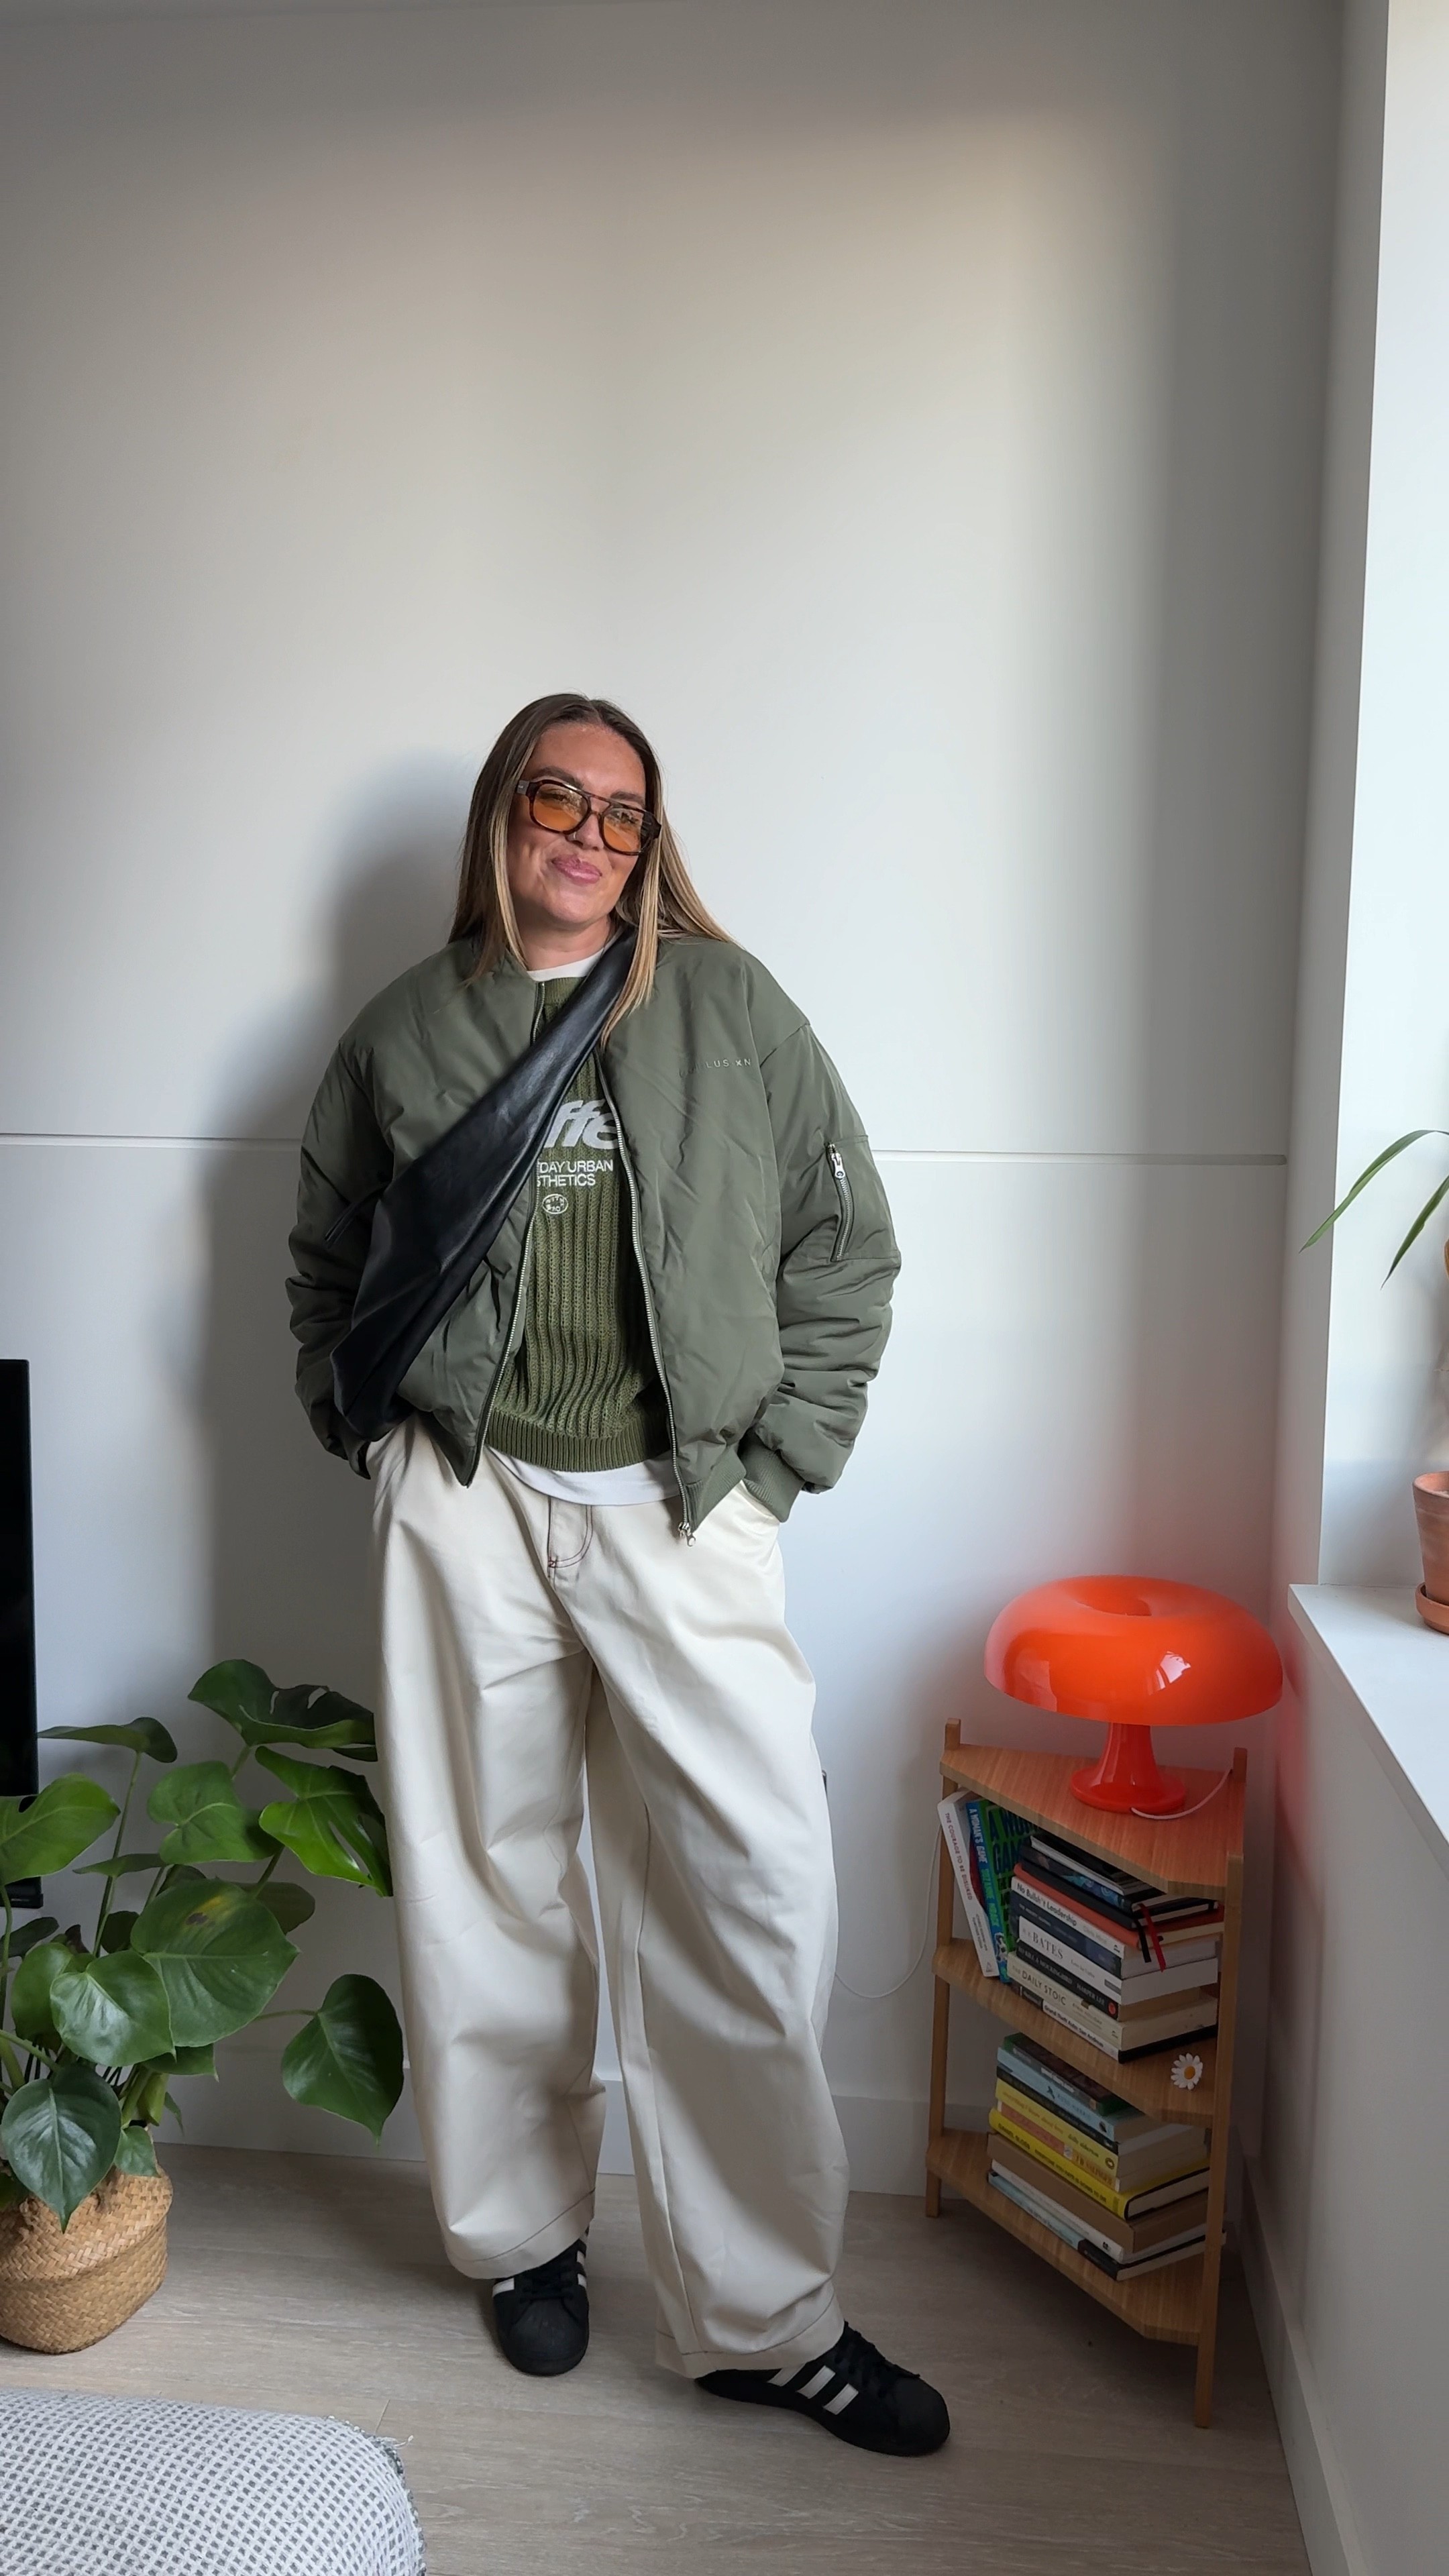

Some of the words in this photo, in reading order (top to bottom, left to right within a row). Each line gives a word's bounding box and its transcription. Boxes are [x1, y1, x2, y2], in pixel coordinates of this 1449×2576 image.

[537, 1159, 565, 1173] DAY
[566, 1159, 614, 1173] URBAN
[948, 1824, 961, 1855] COURAGE
[956, 1855, 963, 1864] TO
[961, 1874, 973, 1900] DISLIKED
[1016, 1882, 1026, 1894] No
[1046, 1900, 1077, 1927] Leadership
[1032, 1931, 1063, 1960] BATES
[1022, 1970, 1042, 1988] DAILY
[1044, 1984, 1067, 2006] STOIC
